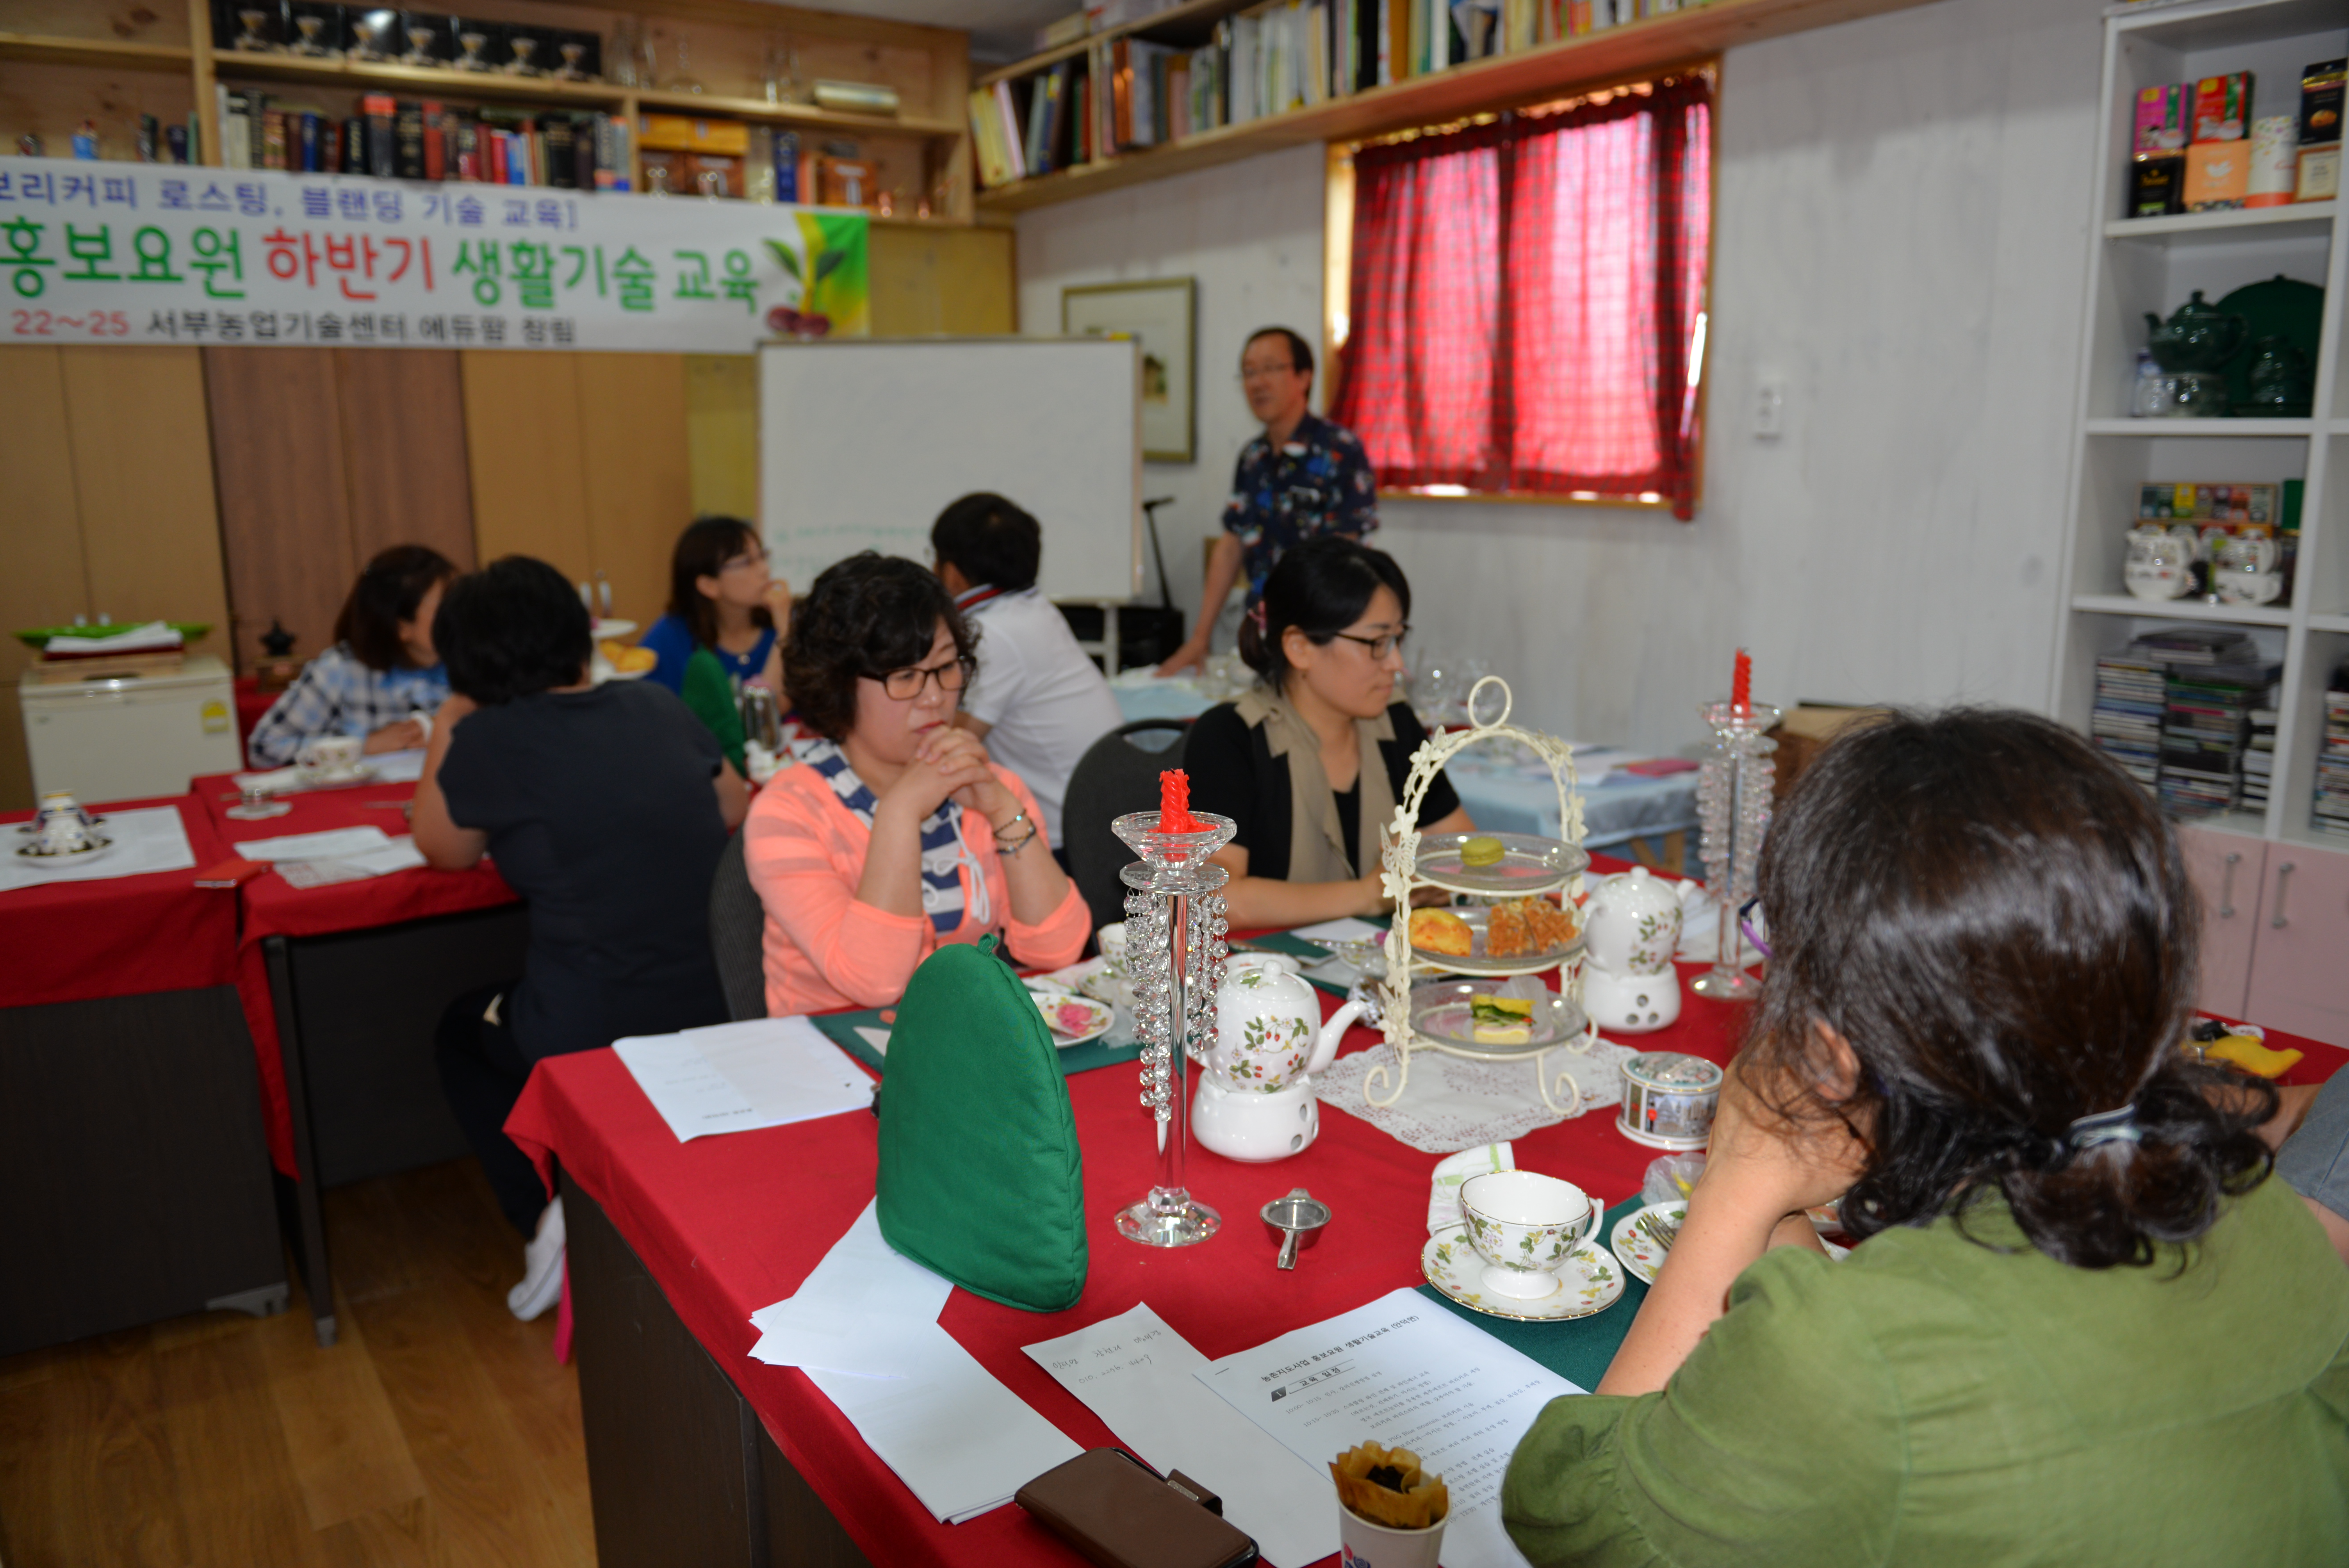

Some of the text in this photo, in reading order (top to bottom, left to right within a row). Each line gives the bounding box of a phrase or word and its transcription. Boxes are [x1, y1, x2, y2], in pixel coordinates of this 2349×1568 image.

[422, 194, 485, 229] 기술
[0, 215, 245, 300] 홍보요원
[263, 227, 435, 300] 하반기
[1260, 1315, 1419, 1382] 농촌지도사업 홍보요원 생활기술교육 (안덕면)
[1299, 1376, 1319, 1387] 교육
[1321, 1367, 1341, 1377] 일정
[1387, 1434, 1402, 1442] PNG
